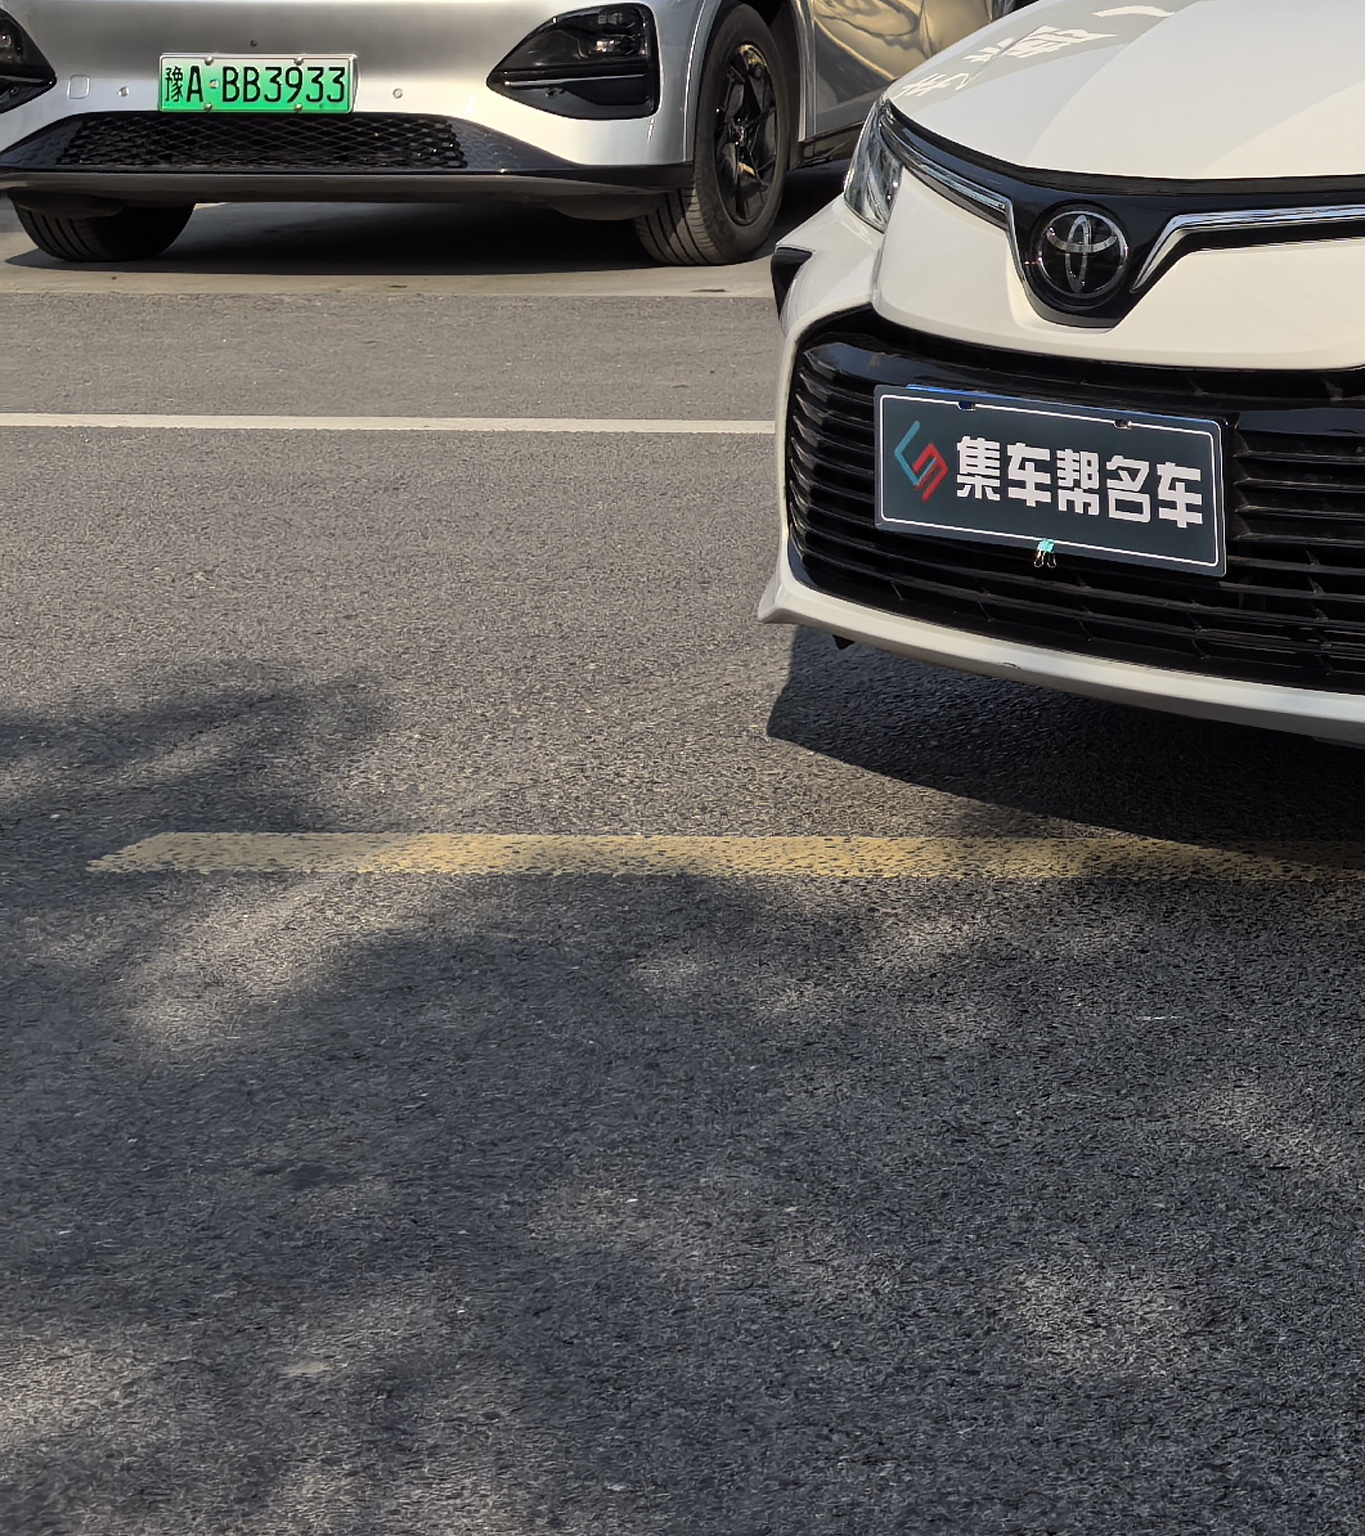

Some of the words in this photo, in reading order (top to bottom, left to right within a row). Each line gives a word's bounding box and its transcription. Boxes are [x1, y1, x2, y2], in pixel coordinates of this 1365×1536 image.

[956, 435, 1203, 529] 集车帮名车
